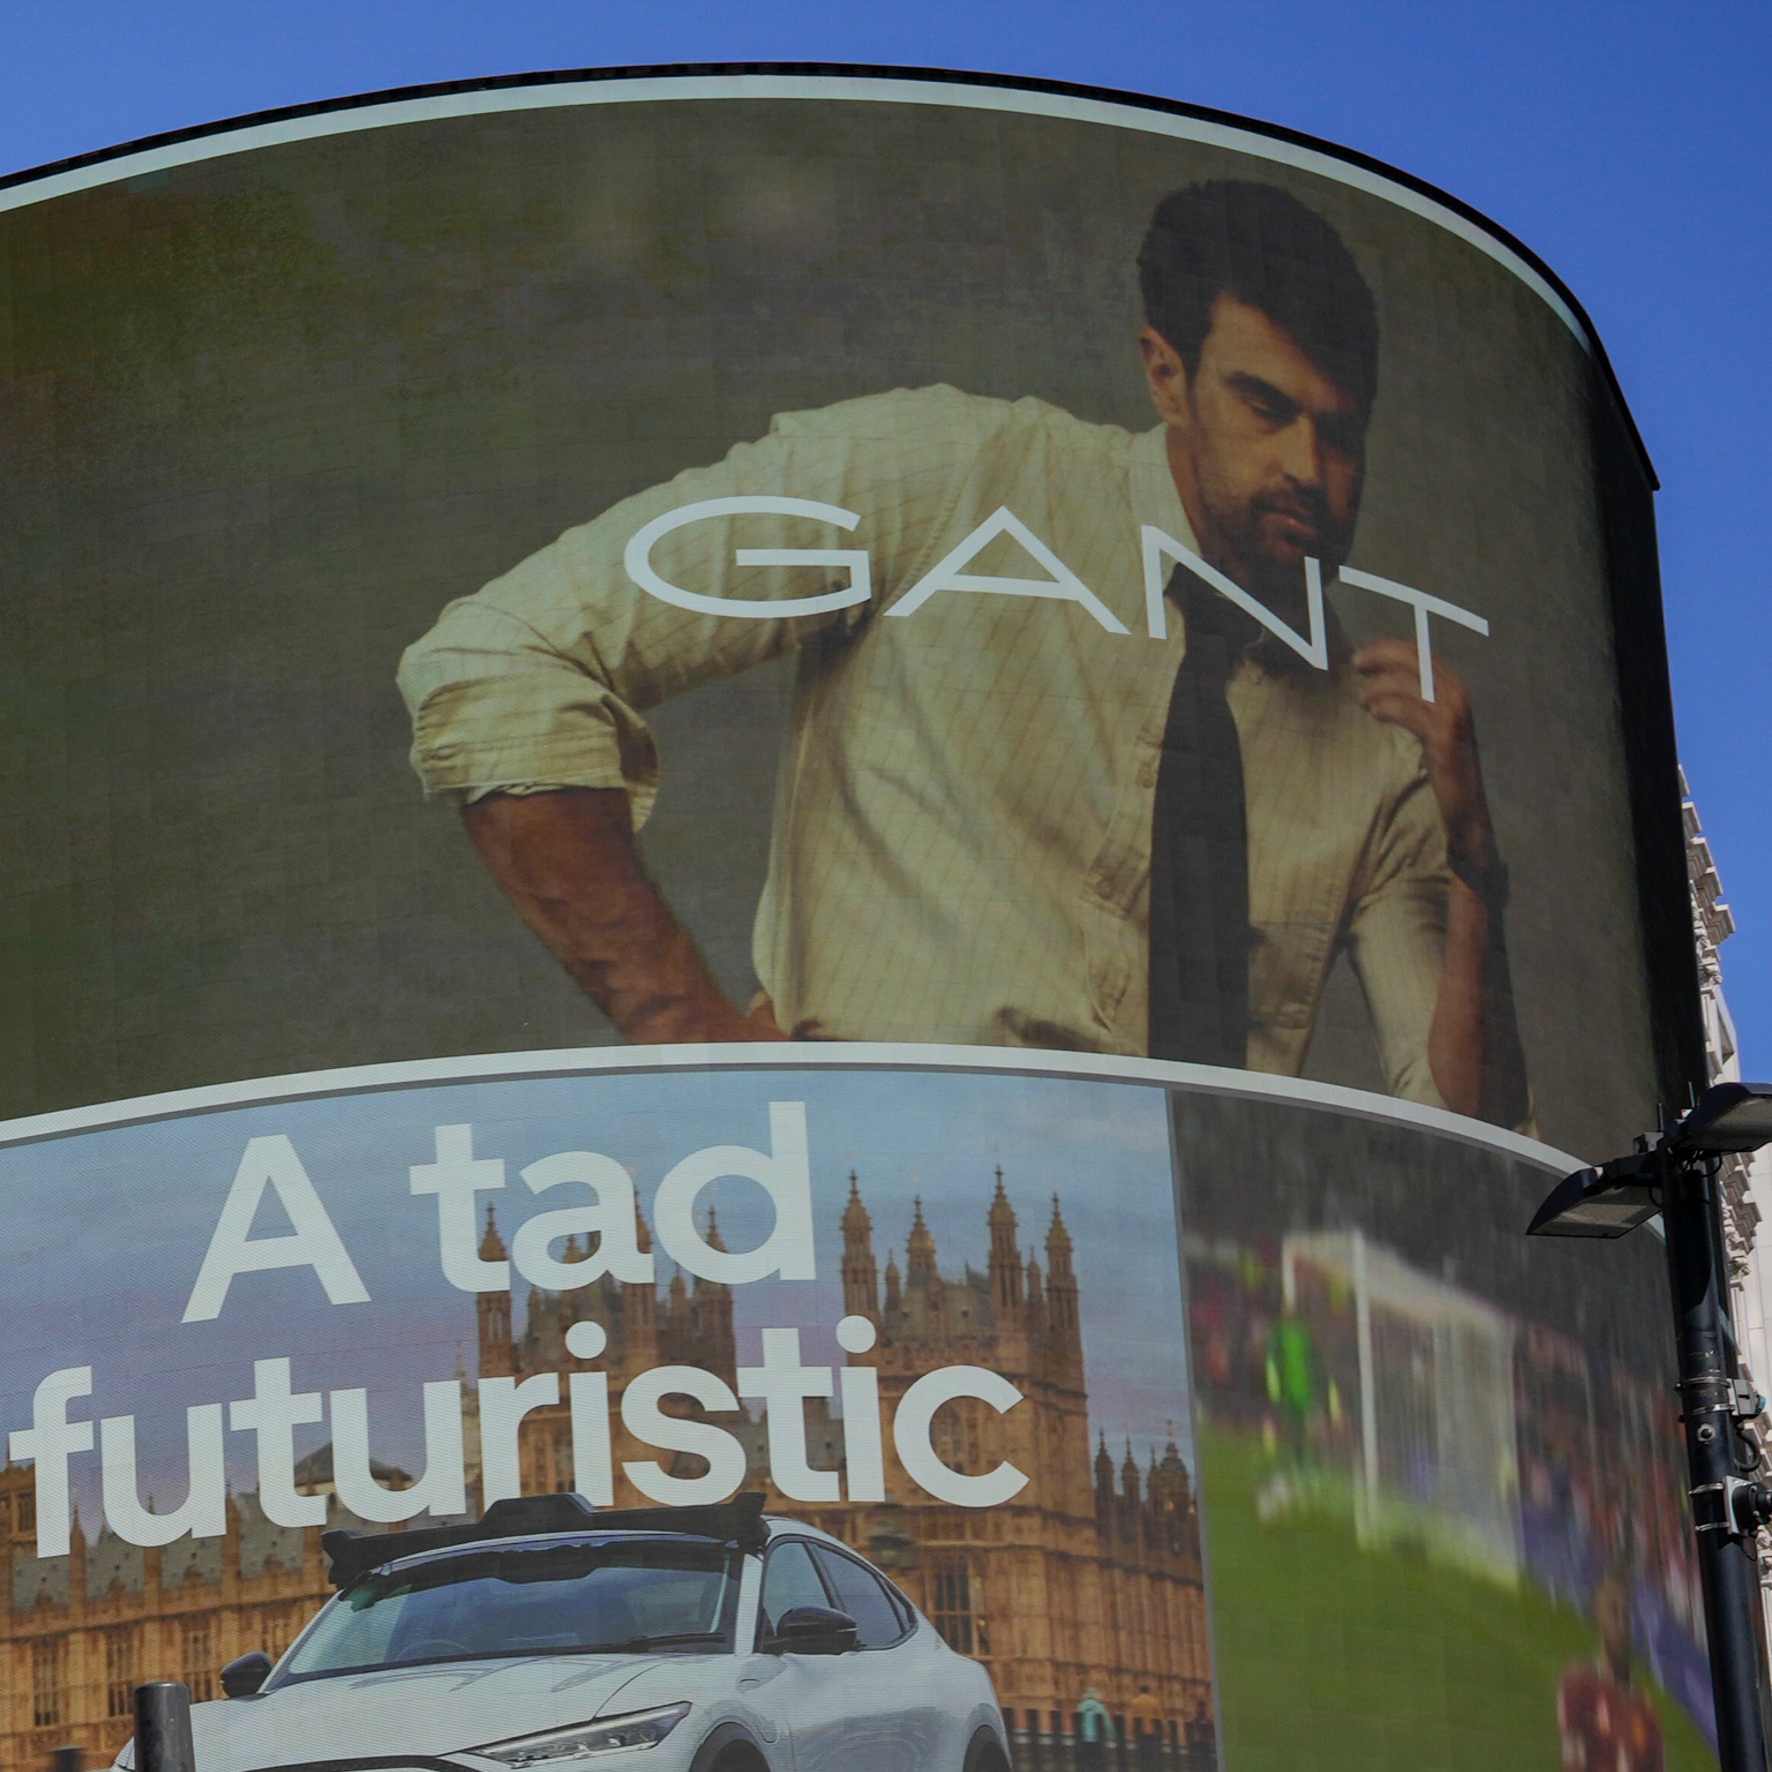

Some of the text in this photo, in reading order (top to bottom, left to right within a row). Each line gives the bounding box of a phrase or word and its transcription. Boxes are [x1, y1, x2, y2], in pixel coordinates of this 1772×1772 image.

[623, 494, 1489, 702] GANT
[180, 1101, 817, 1324] A tad
[9, 1314, 1029, 1560] futuristic
